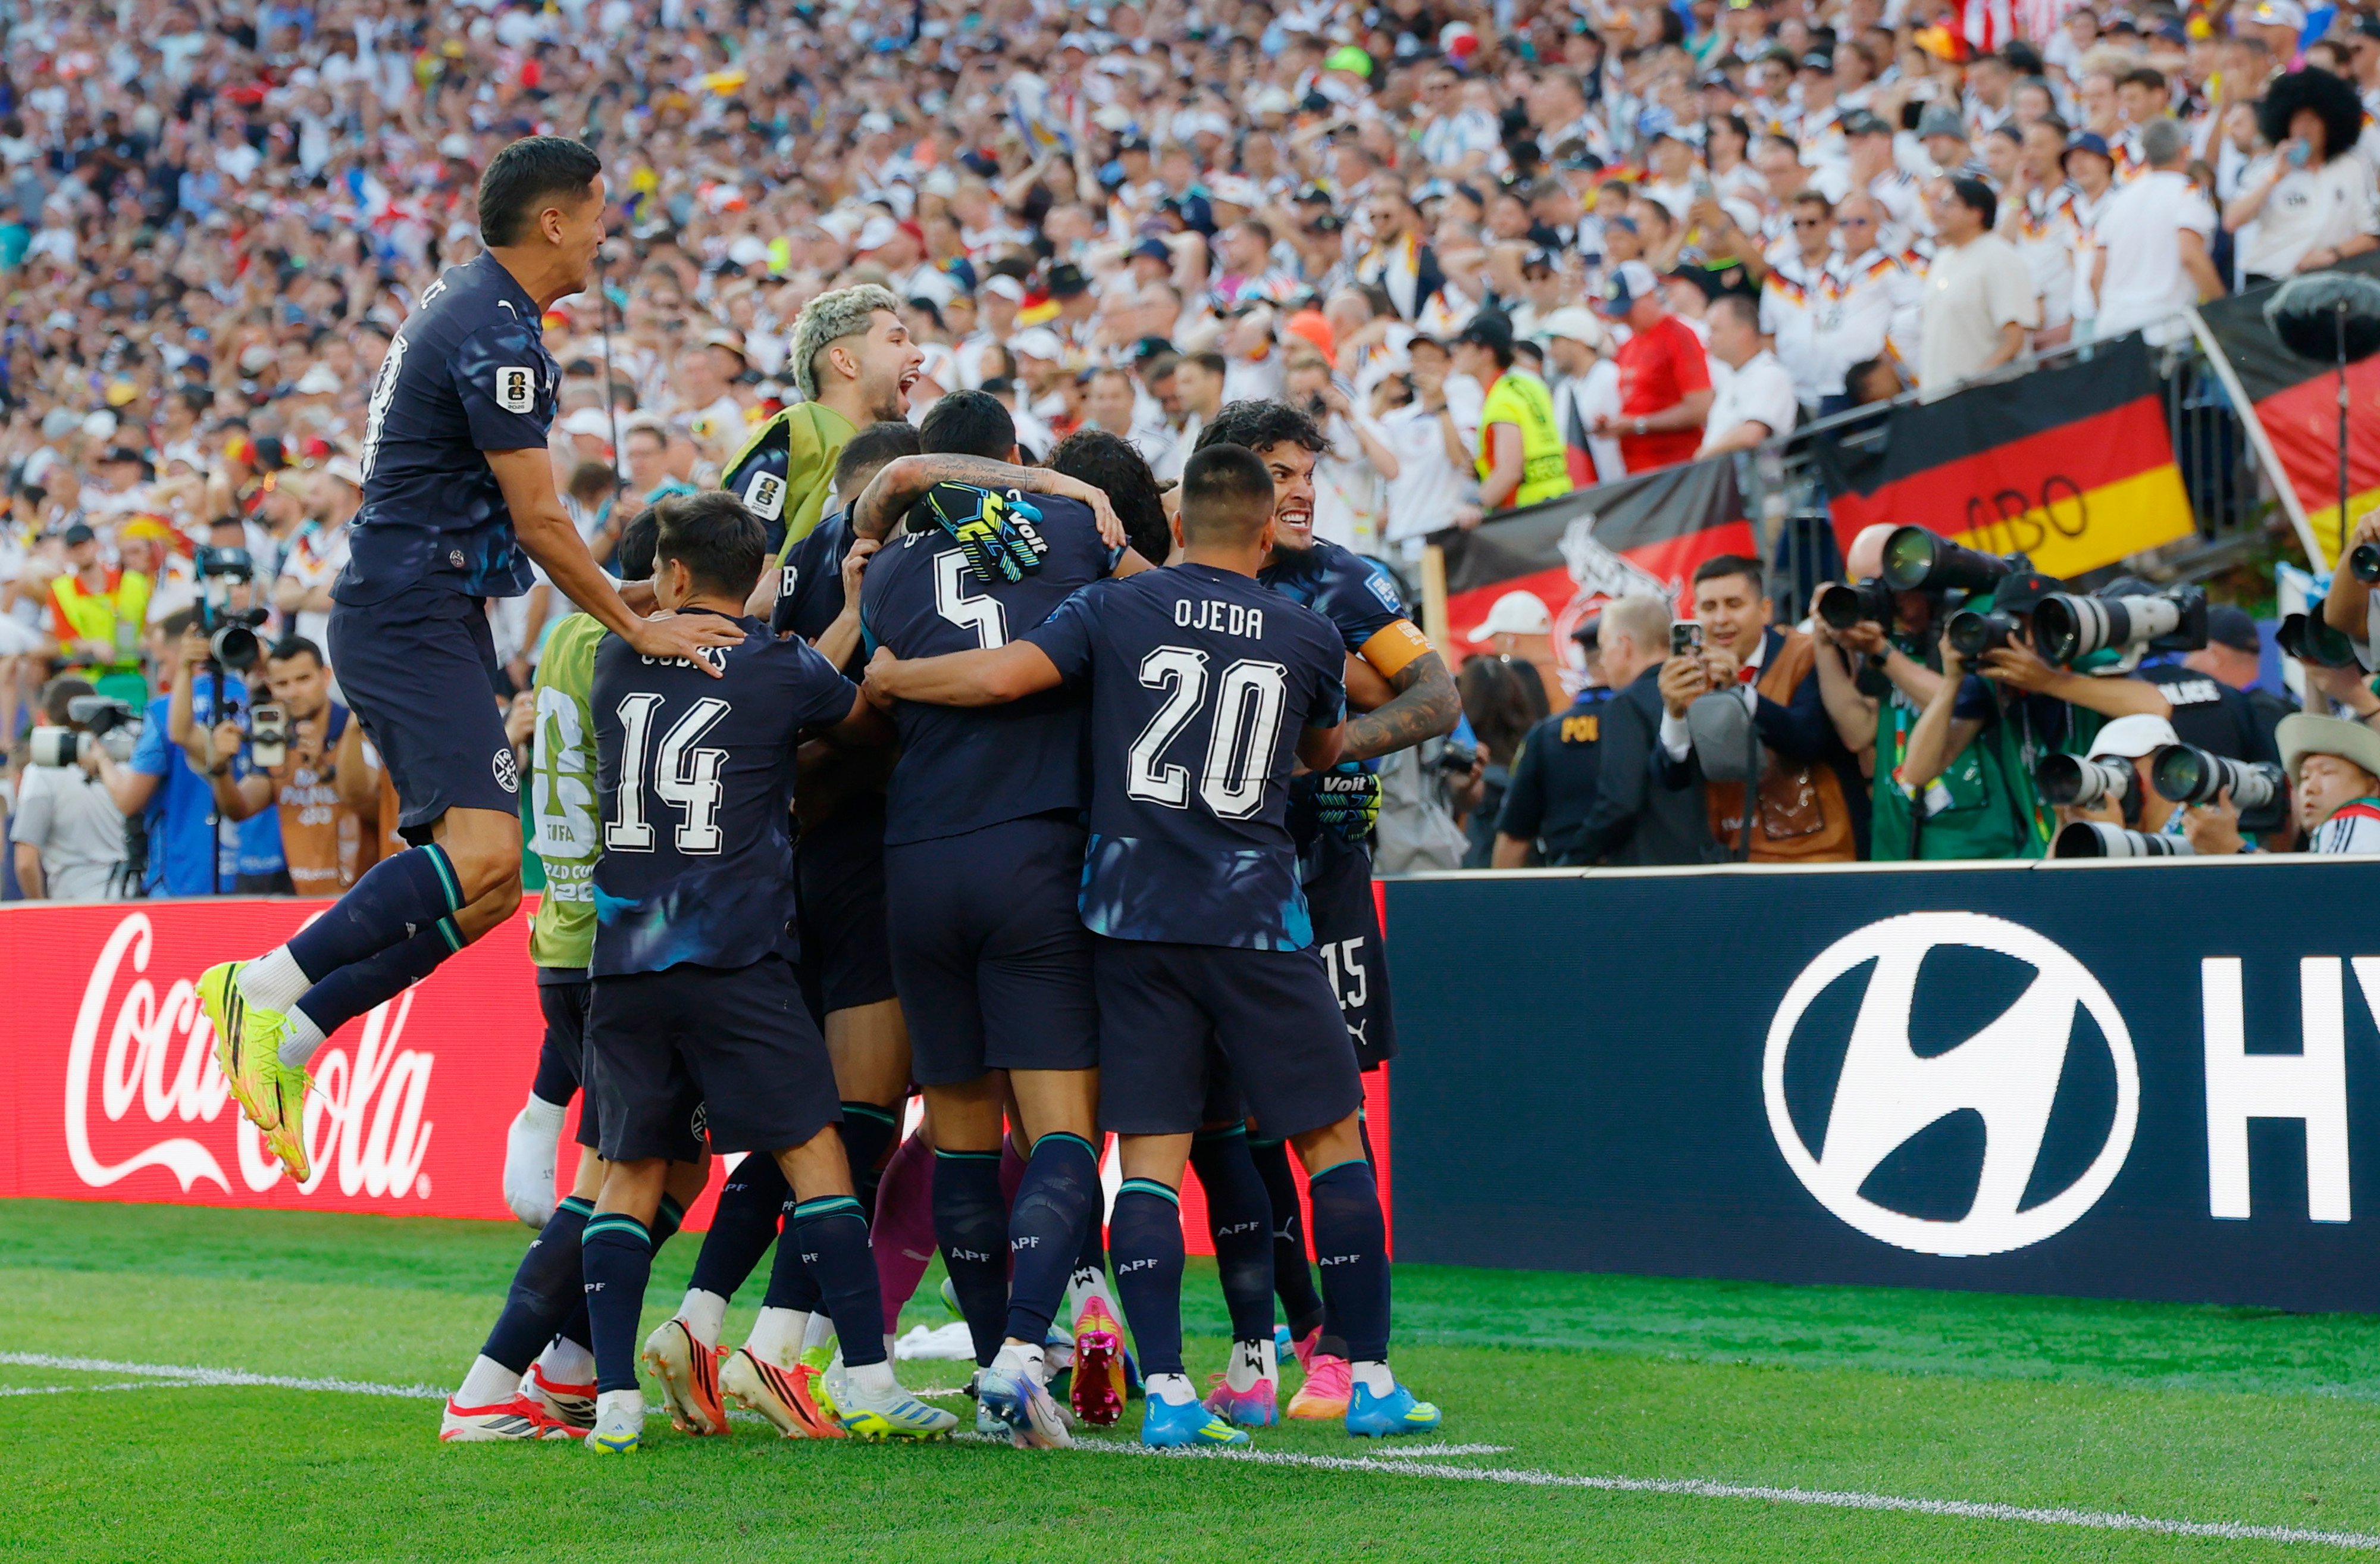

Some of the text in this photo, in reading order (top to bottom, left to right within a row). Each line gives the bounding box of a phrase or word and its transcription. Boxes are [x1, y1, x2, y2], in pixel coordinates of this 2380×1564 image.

[1007, 511, 1049, 554] Voit
[933, 547, 1009, 650] 5
[1174, 599, 1263, 640] OJEDA
[2157, 679, 2221, 706] LICE
[1126, 645, 1289, 820] 20
[605, 692, 732, 855] 14
[1323, 776, 1367, 792] Voit
[543, 861, 568, 880] RLD
[1319, 936, 1367, 1011] 15
[64, 911, 434, 1199] Cocaola
[2200, 955, 2380, 1225] H
[722, 1183, 748, 1192] PF
[1217, 1221, 1260, 1237] APF
[1011, 1235, 1040, 1253] APF
[801, 1253, 819, 1263] PF
[951, 1247, 991, 1262] APF
[1319, 1254, 1361, 1267] APF
[1119, 1258, 1158, 1276] APF
[584, 1283, 606, 1294] PF
